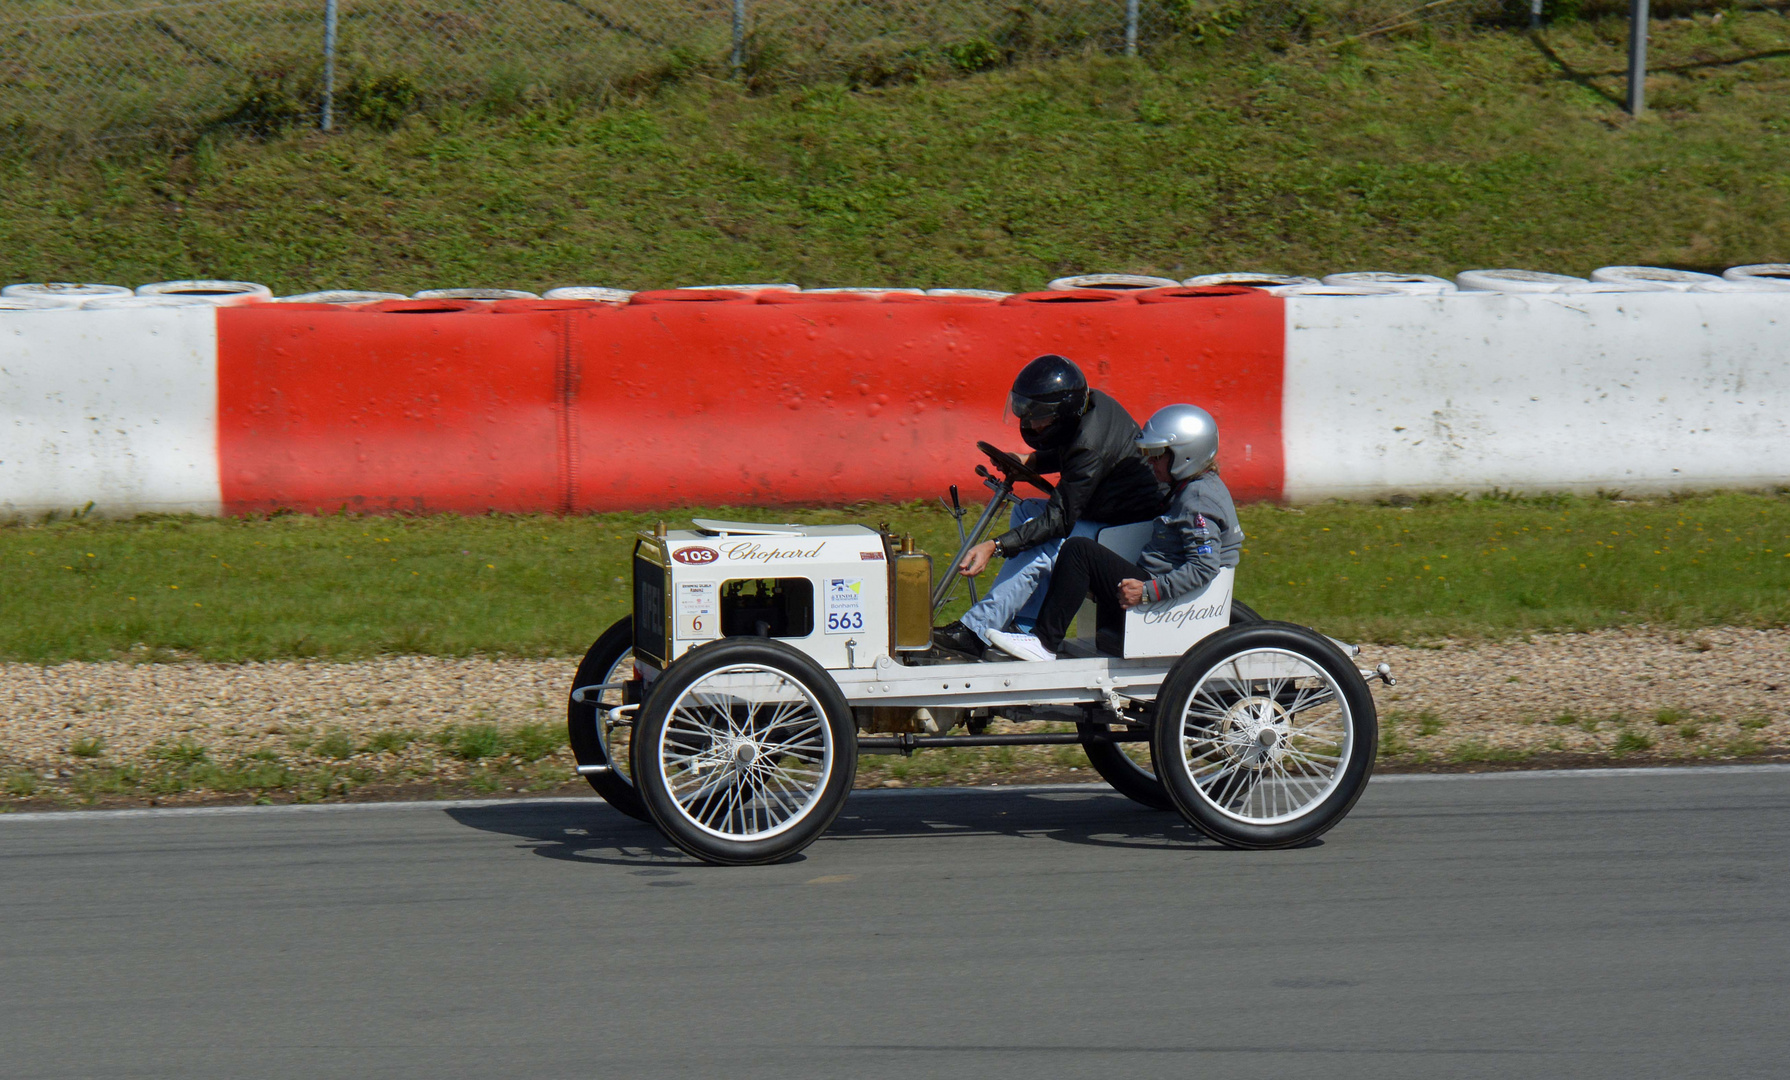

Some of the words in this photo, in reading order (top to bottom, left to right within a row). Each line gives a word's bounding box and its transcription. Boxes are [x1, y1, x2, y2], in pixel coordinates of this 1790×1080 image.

[680, 550, 713, 562] 103
[719, 541, 827, 563] Chopard
[1136, 589, 1230, 629] Chopard
[692, 615, 703, 631] 6
[828, 611, 863, 630] 563
